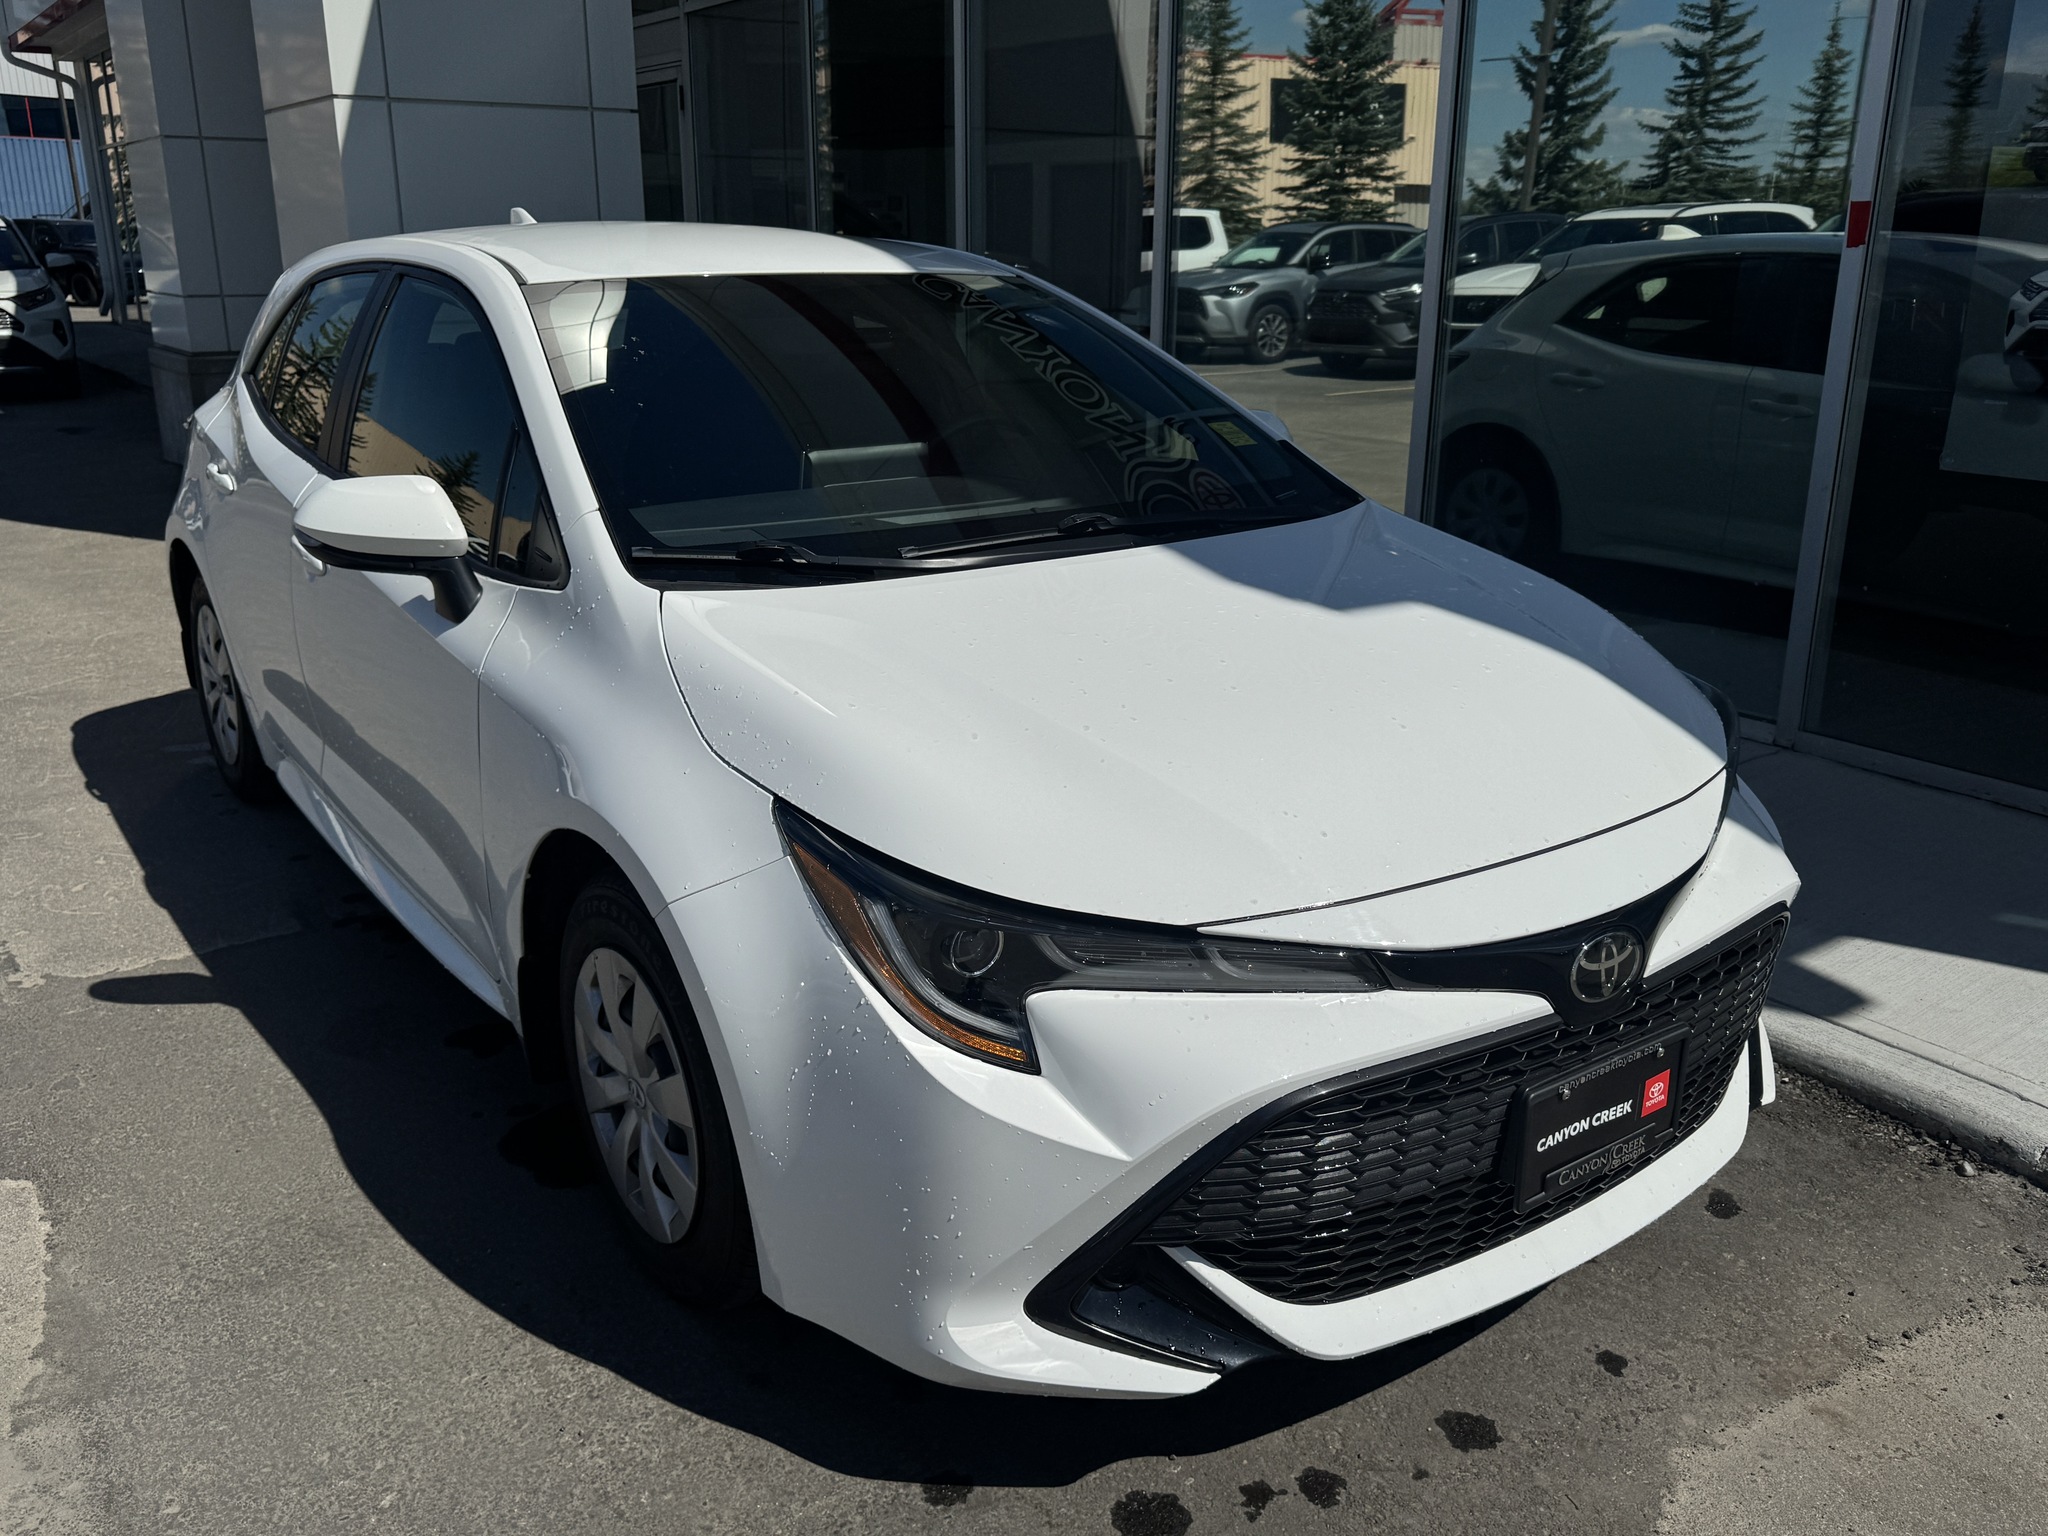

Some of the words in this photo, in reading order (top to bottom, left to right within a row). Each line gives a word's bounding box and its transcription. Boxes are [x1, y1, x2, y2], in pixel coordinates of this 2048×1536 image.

[1645, 1094, 1665, 1108] TOYOTA
[1536, 1116, 1590, 1153] CANYON
[1591, 1099, 1634, 1127] CREEK
[1558, 1153, 1609, 1186] CANYON
[1612, 1134, 1646, 1158] CREEK
[1621, 1146, 1646, 1164] TOYOTA
